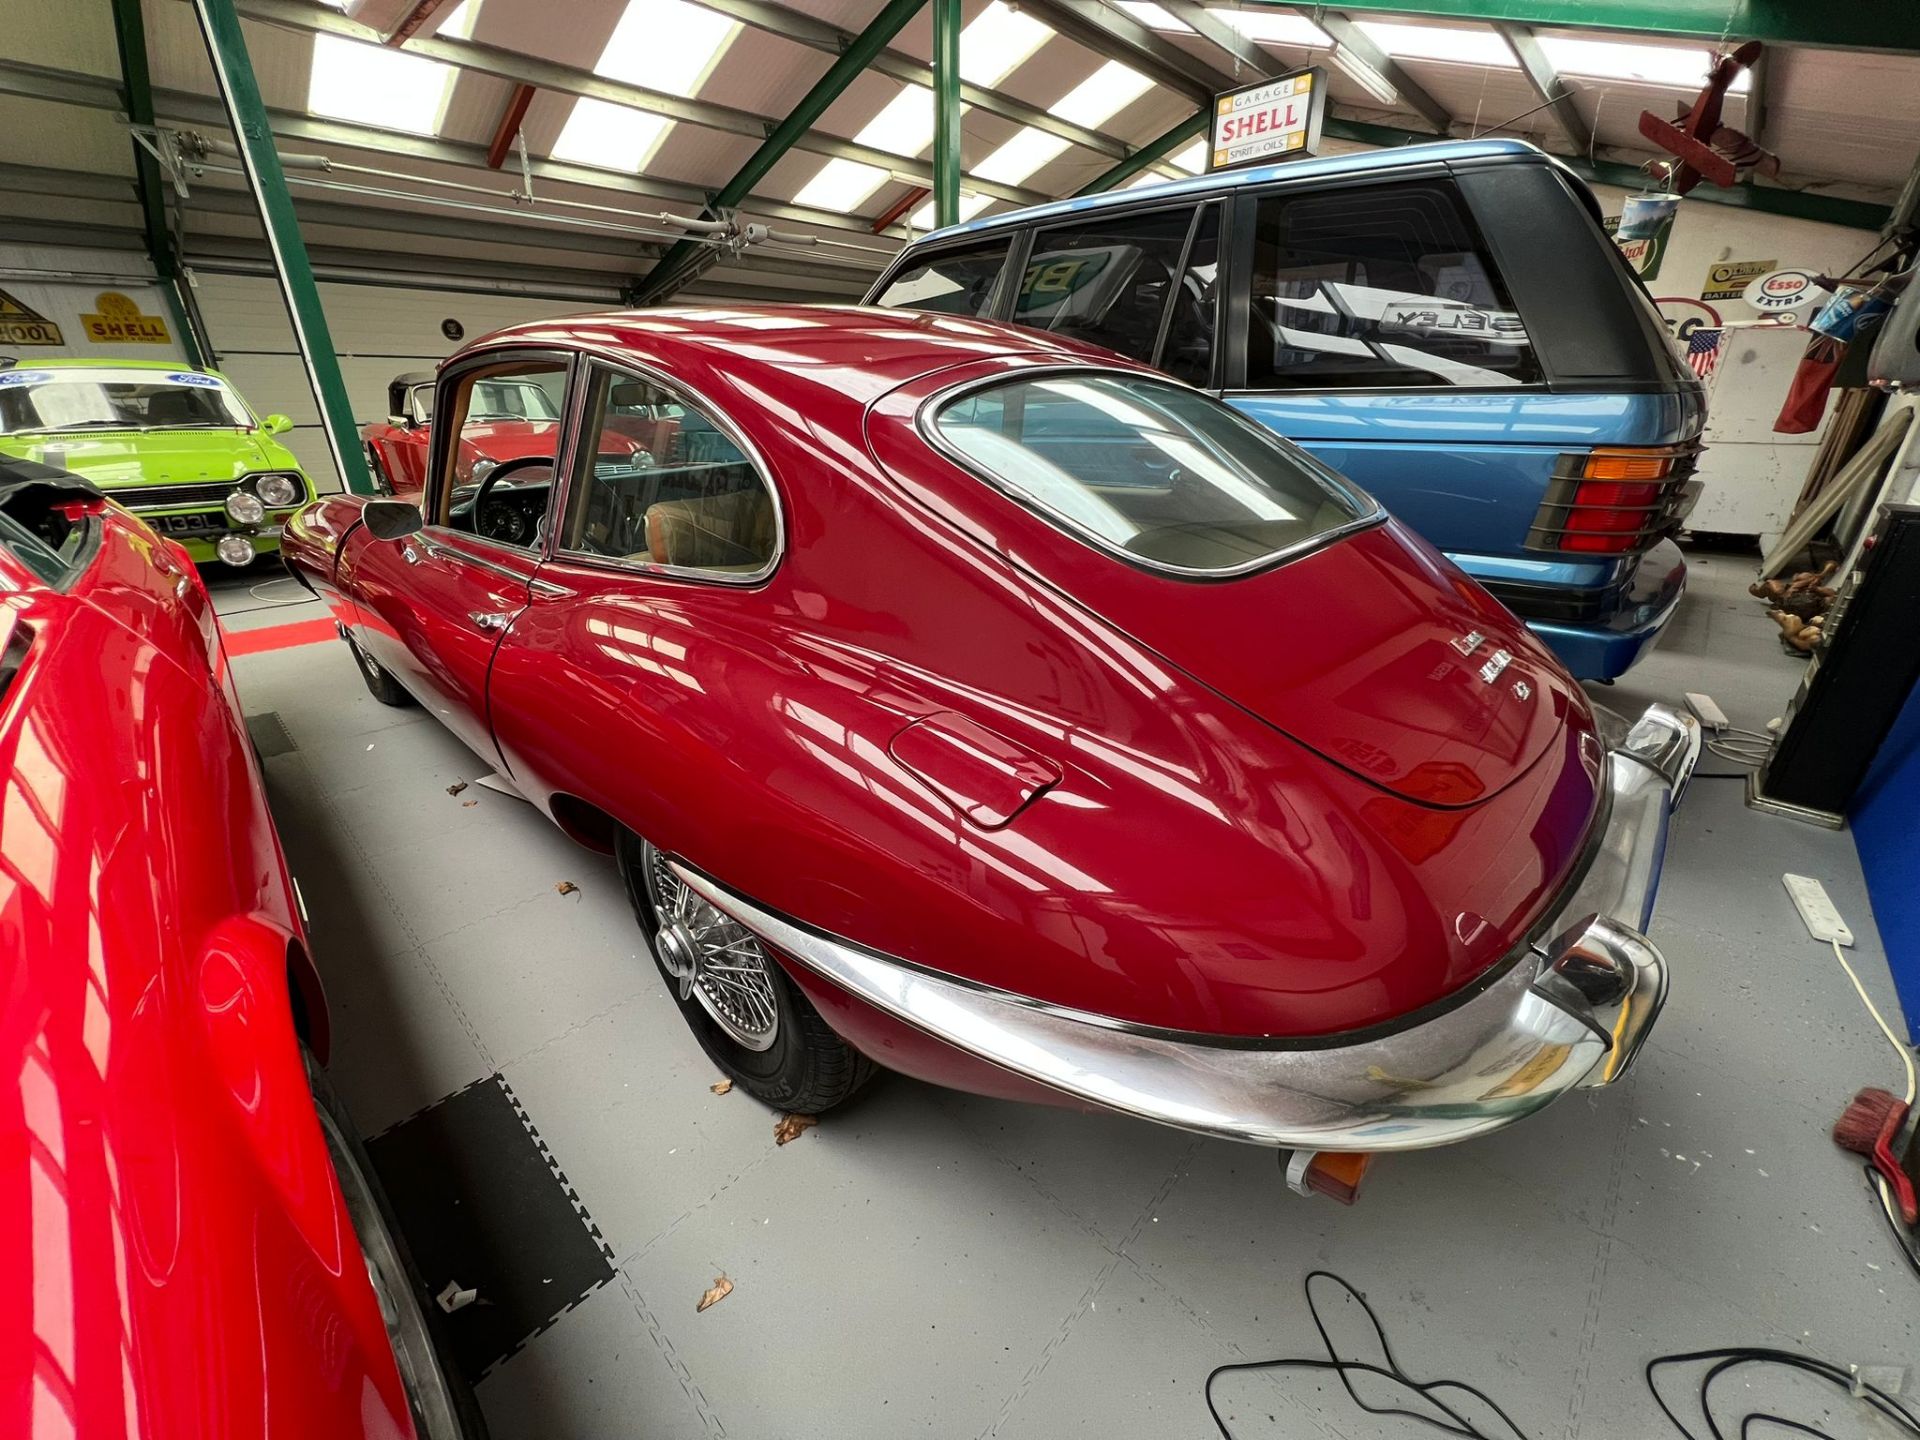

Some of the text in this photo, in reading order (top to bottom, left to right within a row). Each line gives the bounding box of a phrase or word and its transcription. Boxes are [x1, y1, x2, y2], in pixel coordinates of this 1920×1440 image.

[1235, 84, 1290, 107] GARAGE
[1222, 104, 1298, 142] SHELL
[1230, 146, 1254, 159] SPIRIT
[1263, 139, 1284, 151] OILS
[1756, 296, 1804, 307] EXTRA
[92, 323, 165, 337] SHELL
[3, 372, 39, 384] Ford
[177, 374, 213, 386] Ford
[164, 514, 219, 532] 133L
